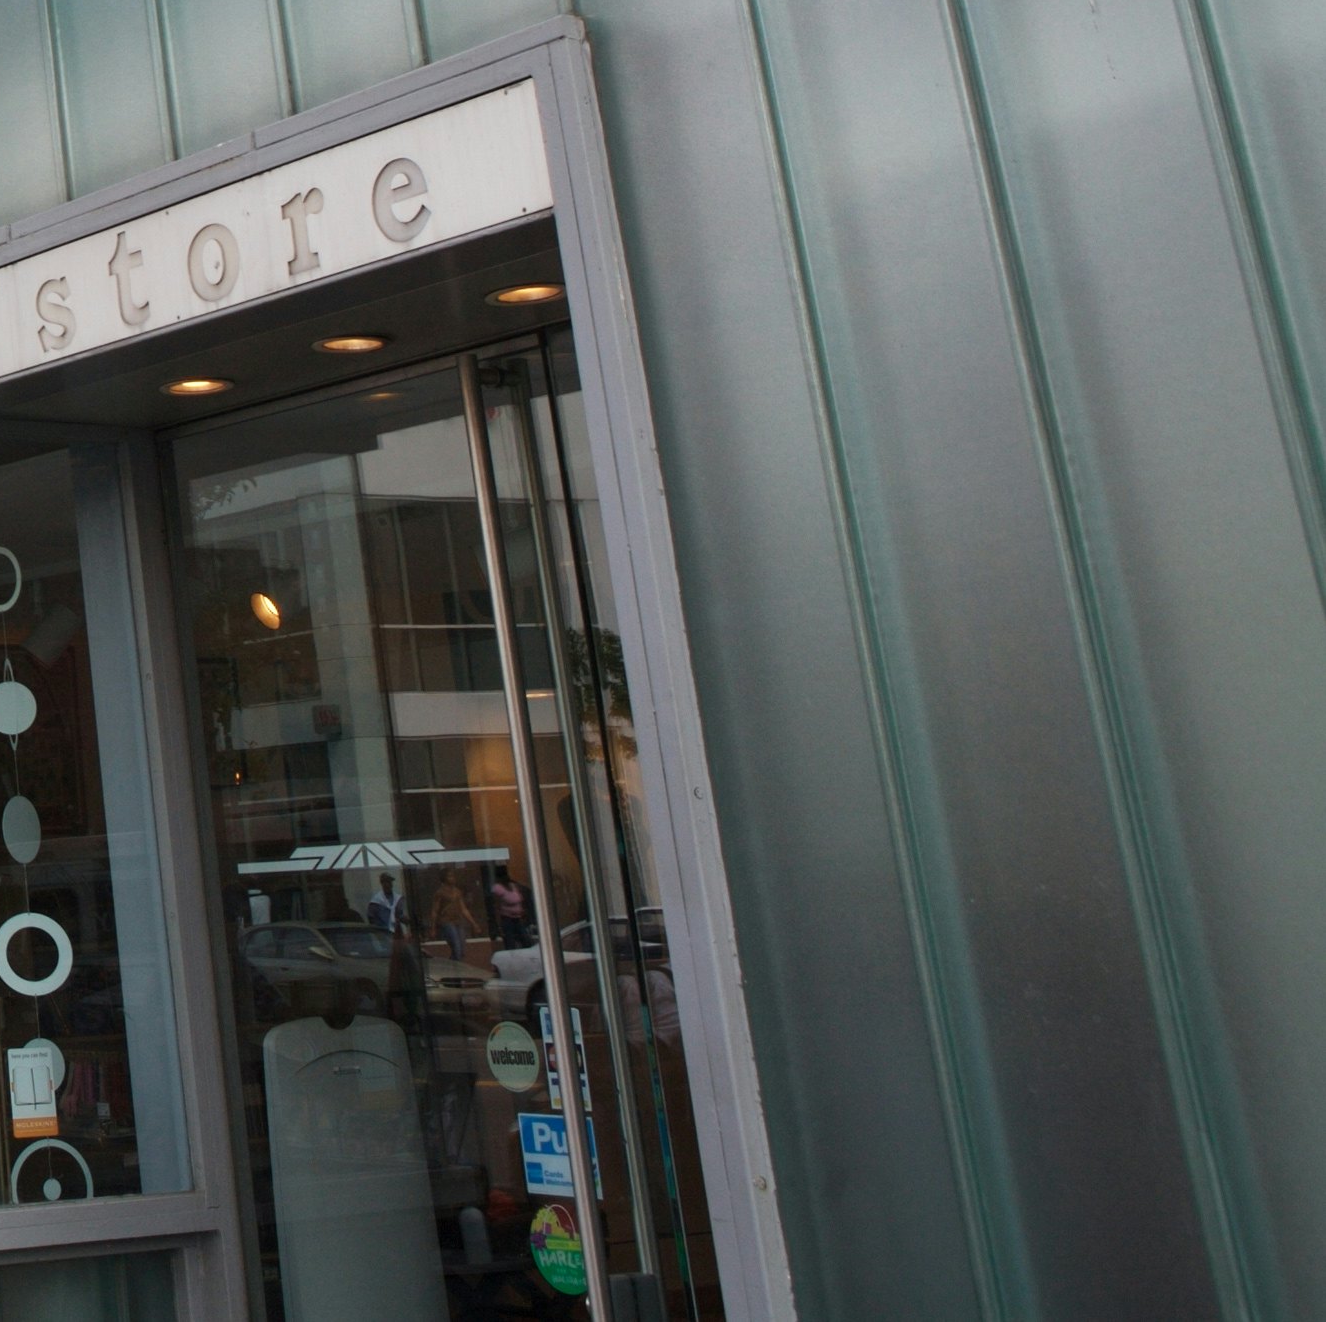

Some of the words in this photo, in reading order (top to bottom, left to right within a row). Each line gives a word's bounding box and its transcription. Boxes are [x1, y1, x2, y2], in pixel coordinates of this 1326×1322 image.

[35, 156, 433, 355] store
[489, 1045, 537, 1067] welcome
[531, 1121, 569, 1155] Pu
[539, 1249, 585, 1271] HARLE
